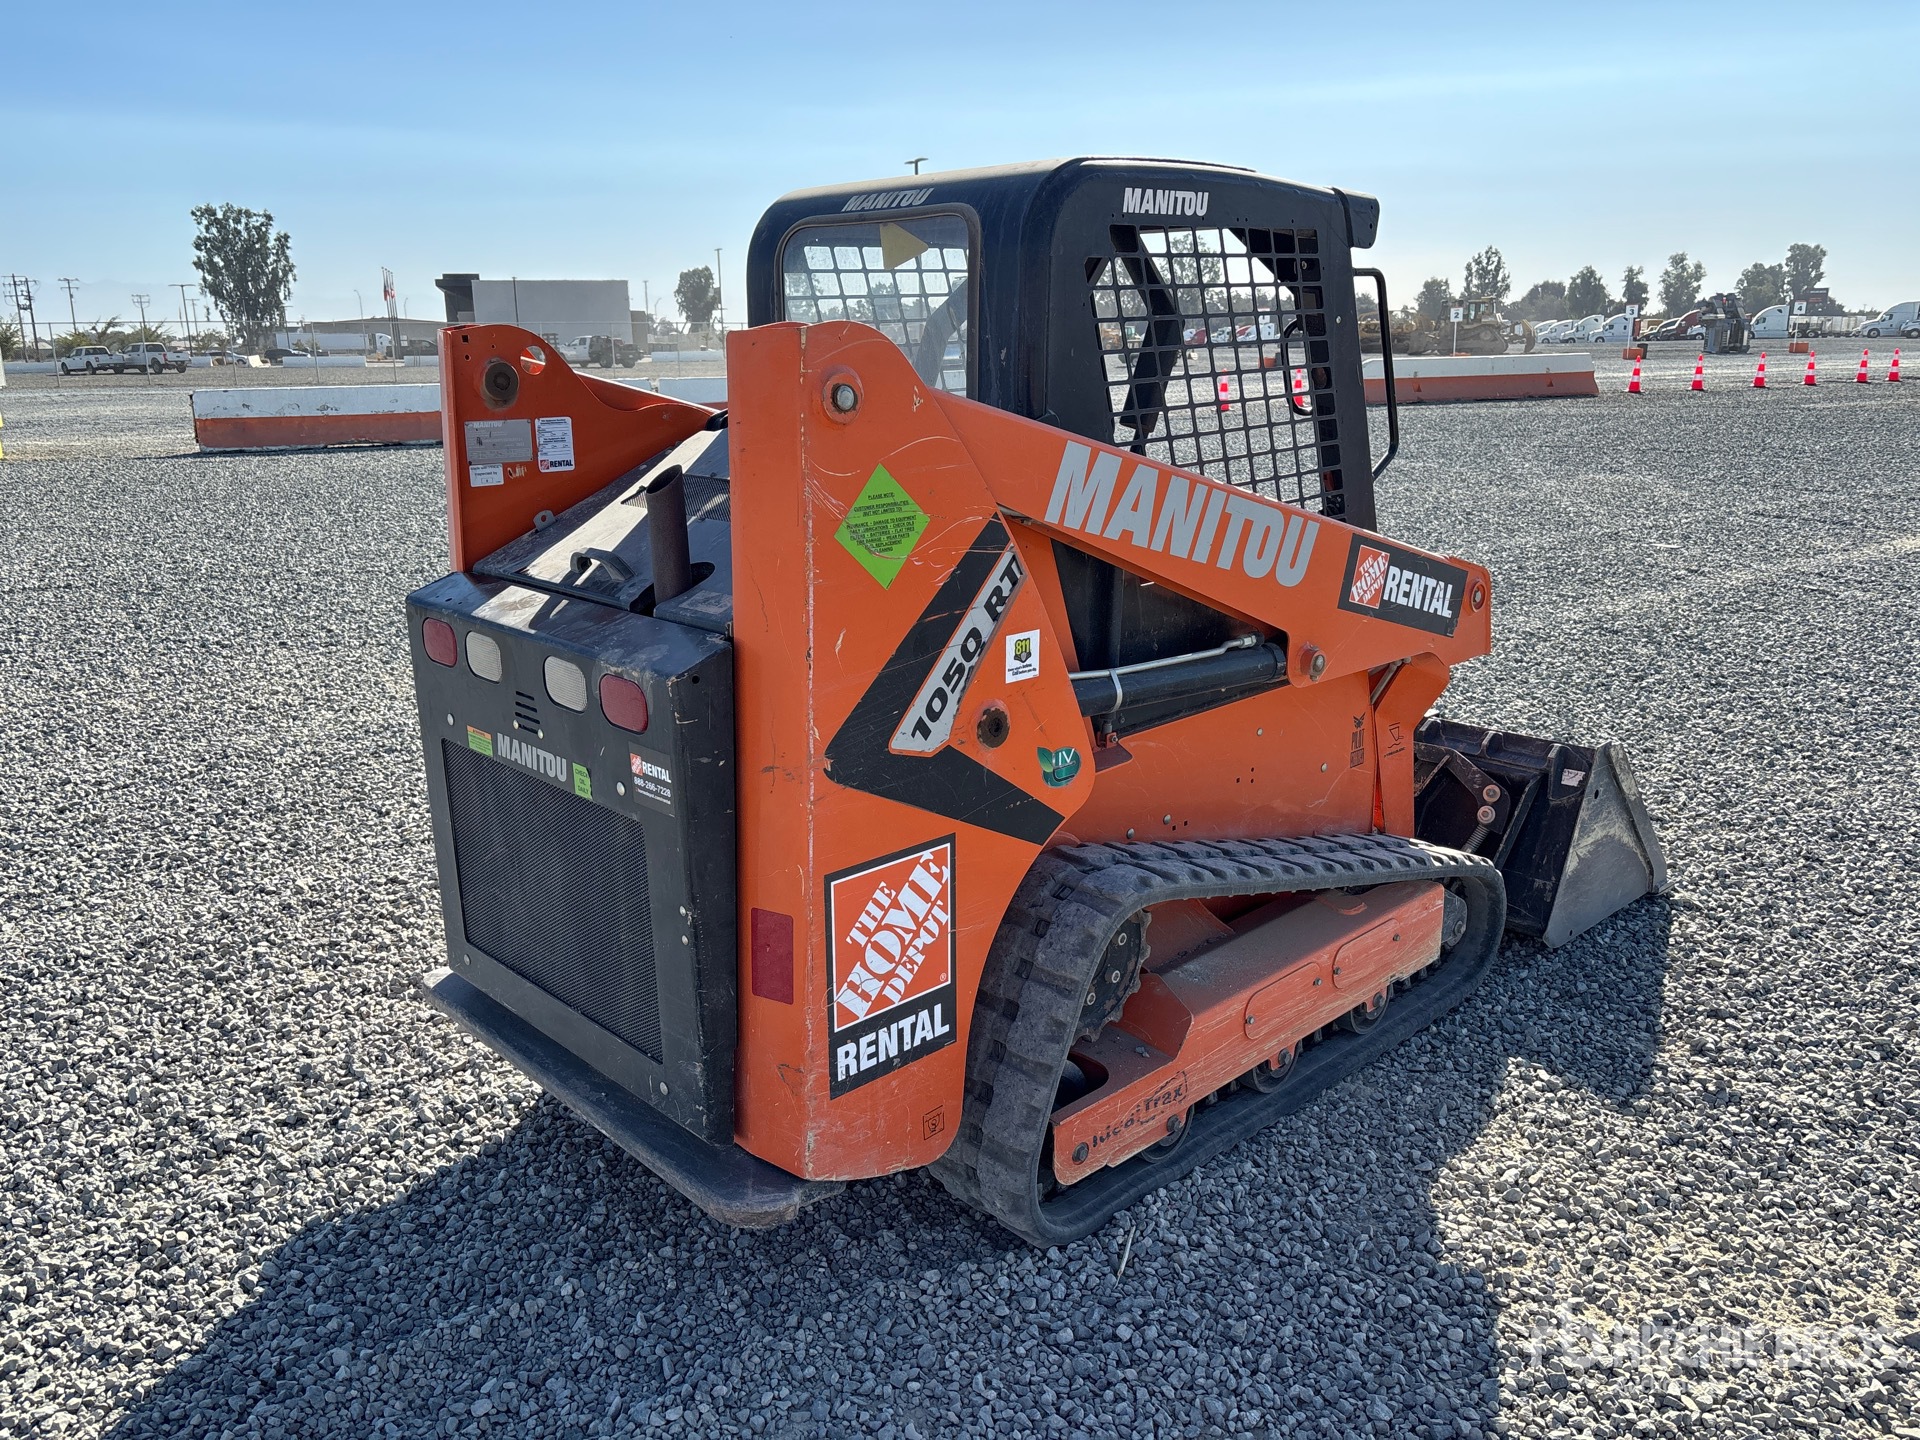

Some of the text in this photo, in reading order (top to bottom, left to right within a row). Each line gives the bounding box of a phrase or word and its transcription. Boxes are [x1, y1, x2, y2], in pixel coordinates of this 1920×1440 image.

[841, 188, 935, 213] MANITOU
[1122, 187, 1209, 217] MANITOU
[550, 460, 573, 469] RENTAL
[1044, 439, 1321, 588] MANITOU
[1350, 552, 1388, 602] HOME
[1359, 554, 1375, 576] THE
[1361, 575, 1386, 604] DEPOT
[1383, 565, 1454, 619] RENTAL
[911, 554, 1020, 742] 1050 RT
[1015, 638, 1031, 656] 811
[497, 732, 567, 782] MANITOU
[1058, 748, 1075, 766] IV
[634, 776, 671, 798] 888-266-7228
[642, 761, 672, 784] RENTAL
[578, 785, 589, 794] DAILY
[845, 881, 897, 949] THE
[836, 850, 951, 1020] HOME
[881, 900, 950, 1006] DEPOT
[837, 1002, 951, 1083] RENTAL
